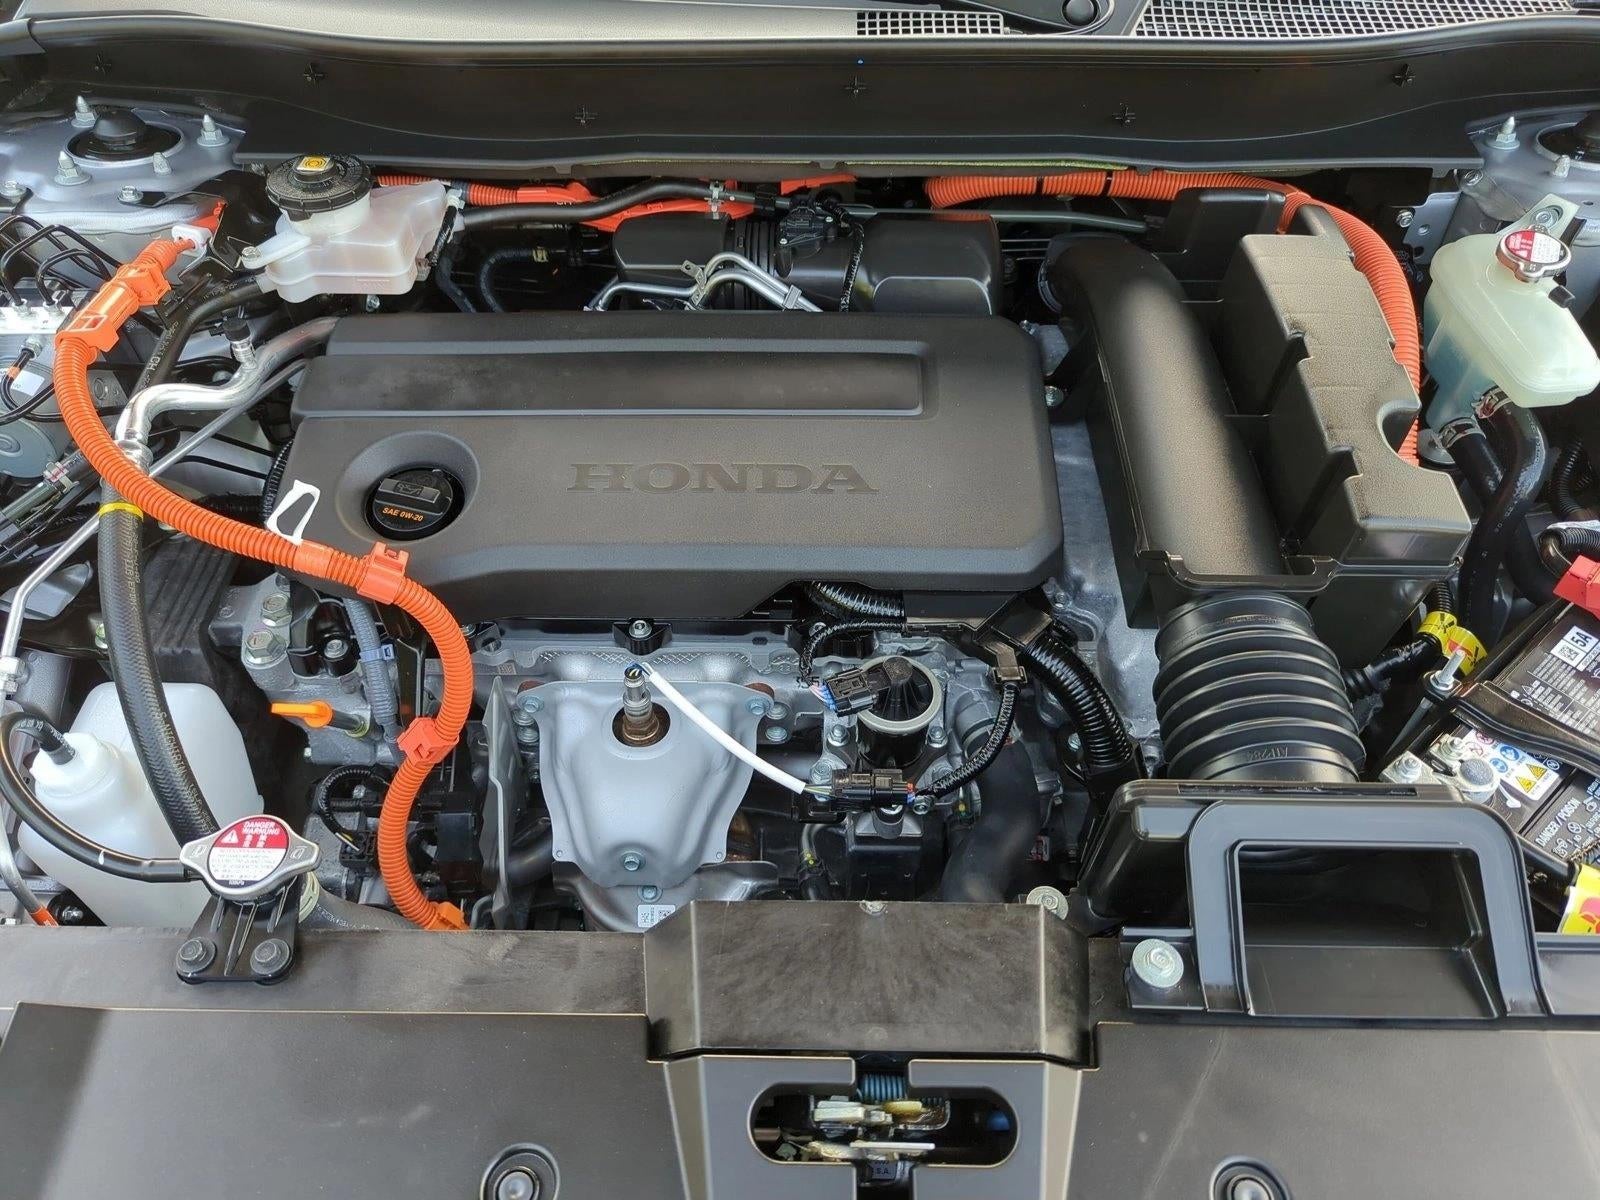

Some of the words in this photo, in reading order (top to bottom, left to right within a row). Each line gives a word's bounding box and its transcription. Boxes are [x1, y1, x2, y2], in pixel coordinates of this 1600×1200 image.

[566, 462, 880, 494] HONDA
[382, 507, 399, 517] SAE
[400, 511, 424, 522] 0W-20
[1571, 632, 1592, 647] 5A
[243, 821, 276, 829] DANGER
